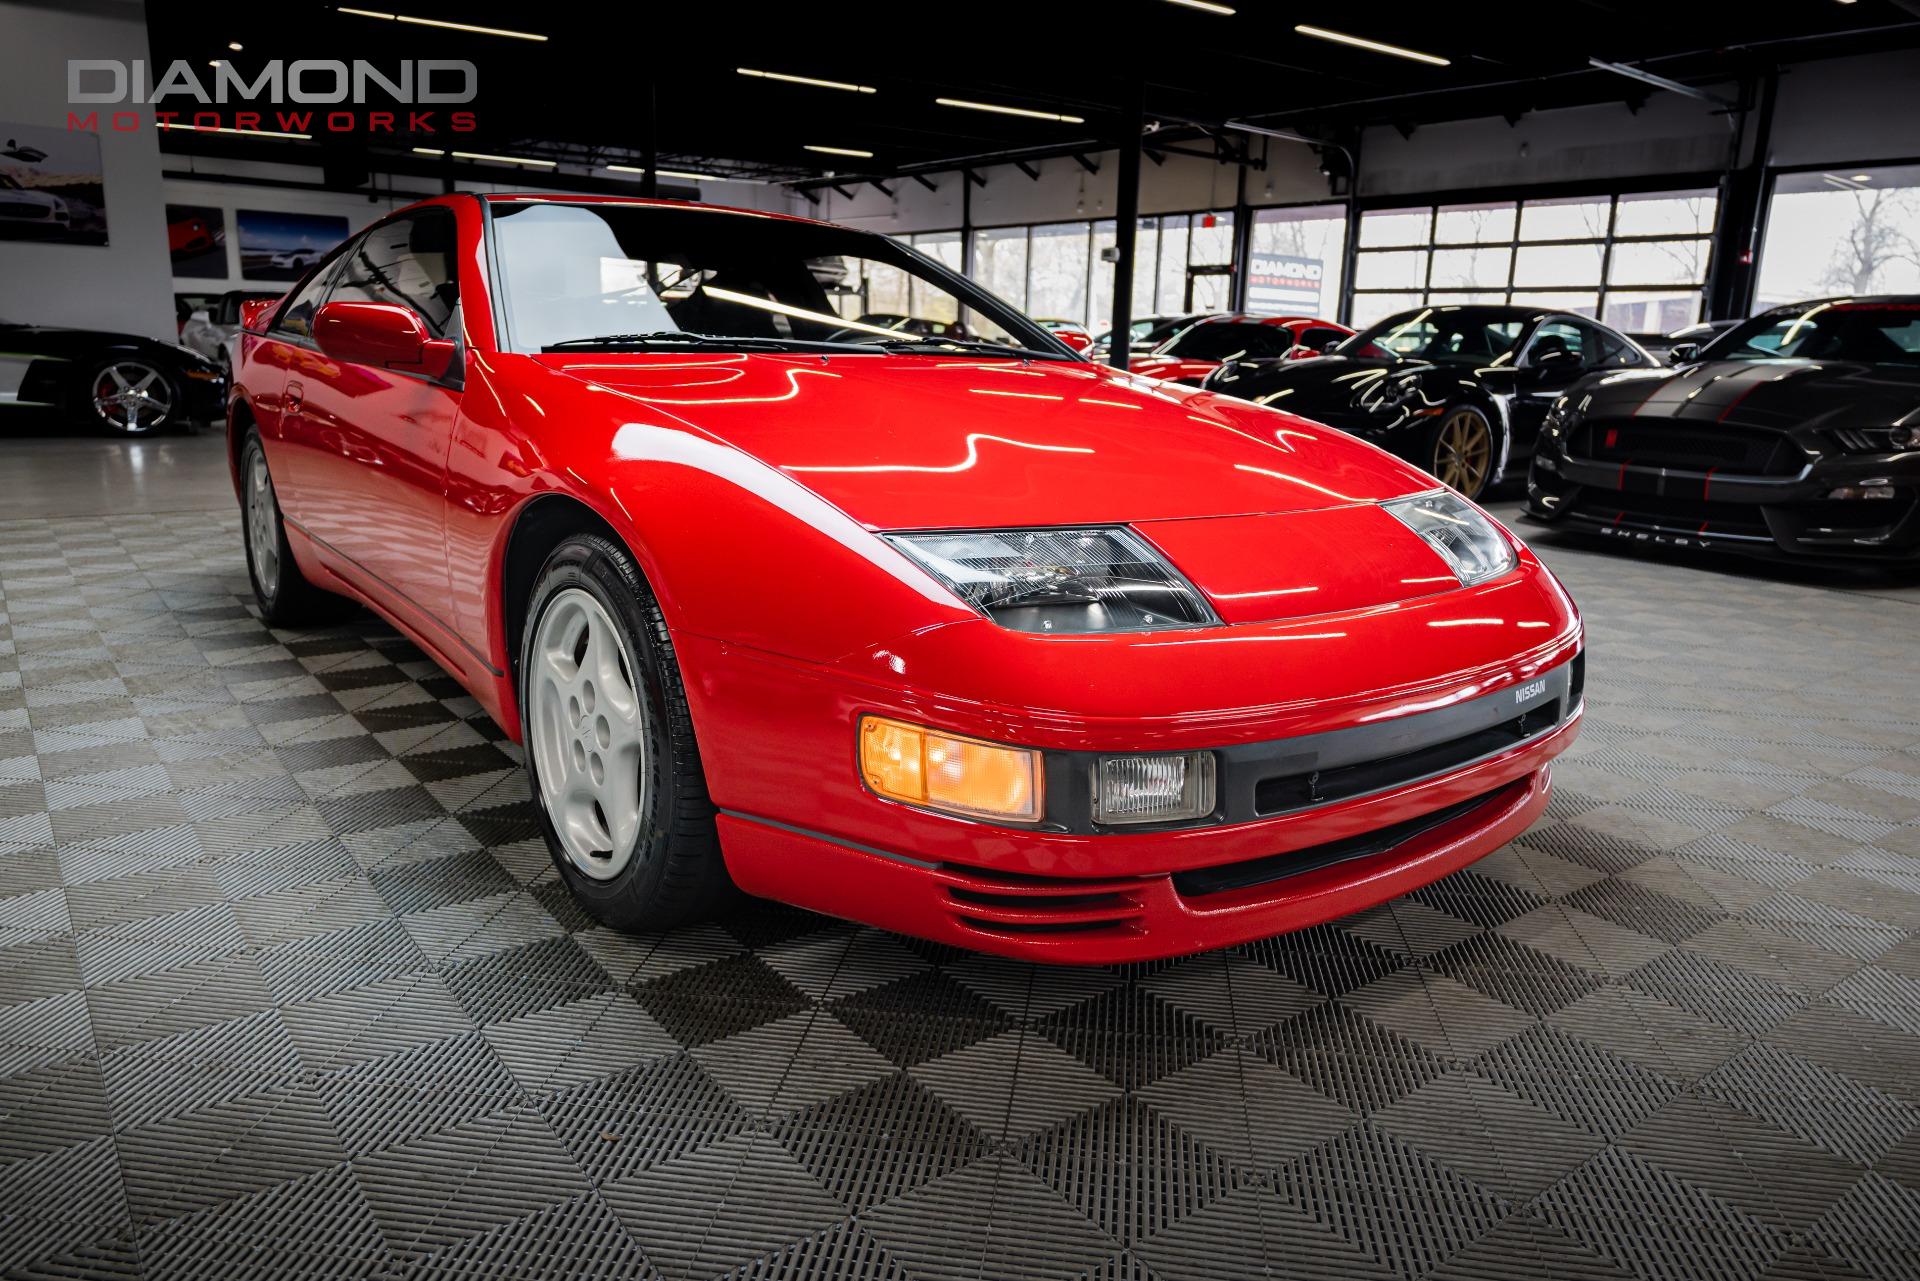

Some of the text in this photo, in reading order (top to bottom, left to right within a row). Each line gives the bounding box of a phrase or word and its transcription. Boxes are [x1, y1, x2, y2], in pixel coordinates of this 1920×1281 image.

[1250, 258, 1322, 280] DIAMOND
[1600, 527, 1712, 548] SHELBY
[1515, 680, 1546, 704] NISSAN
